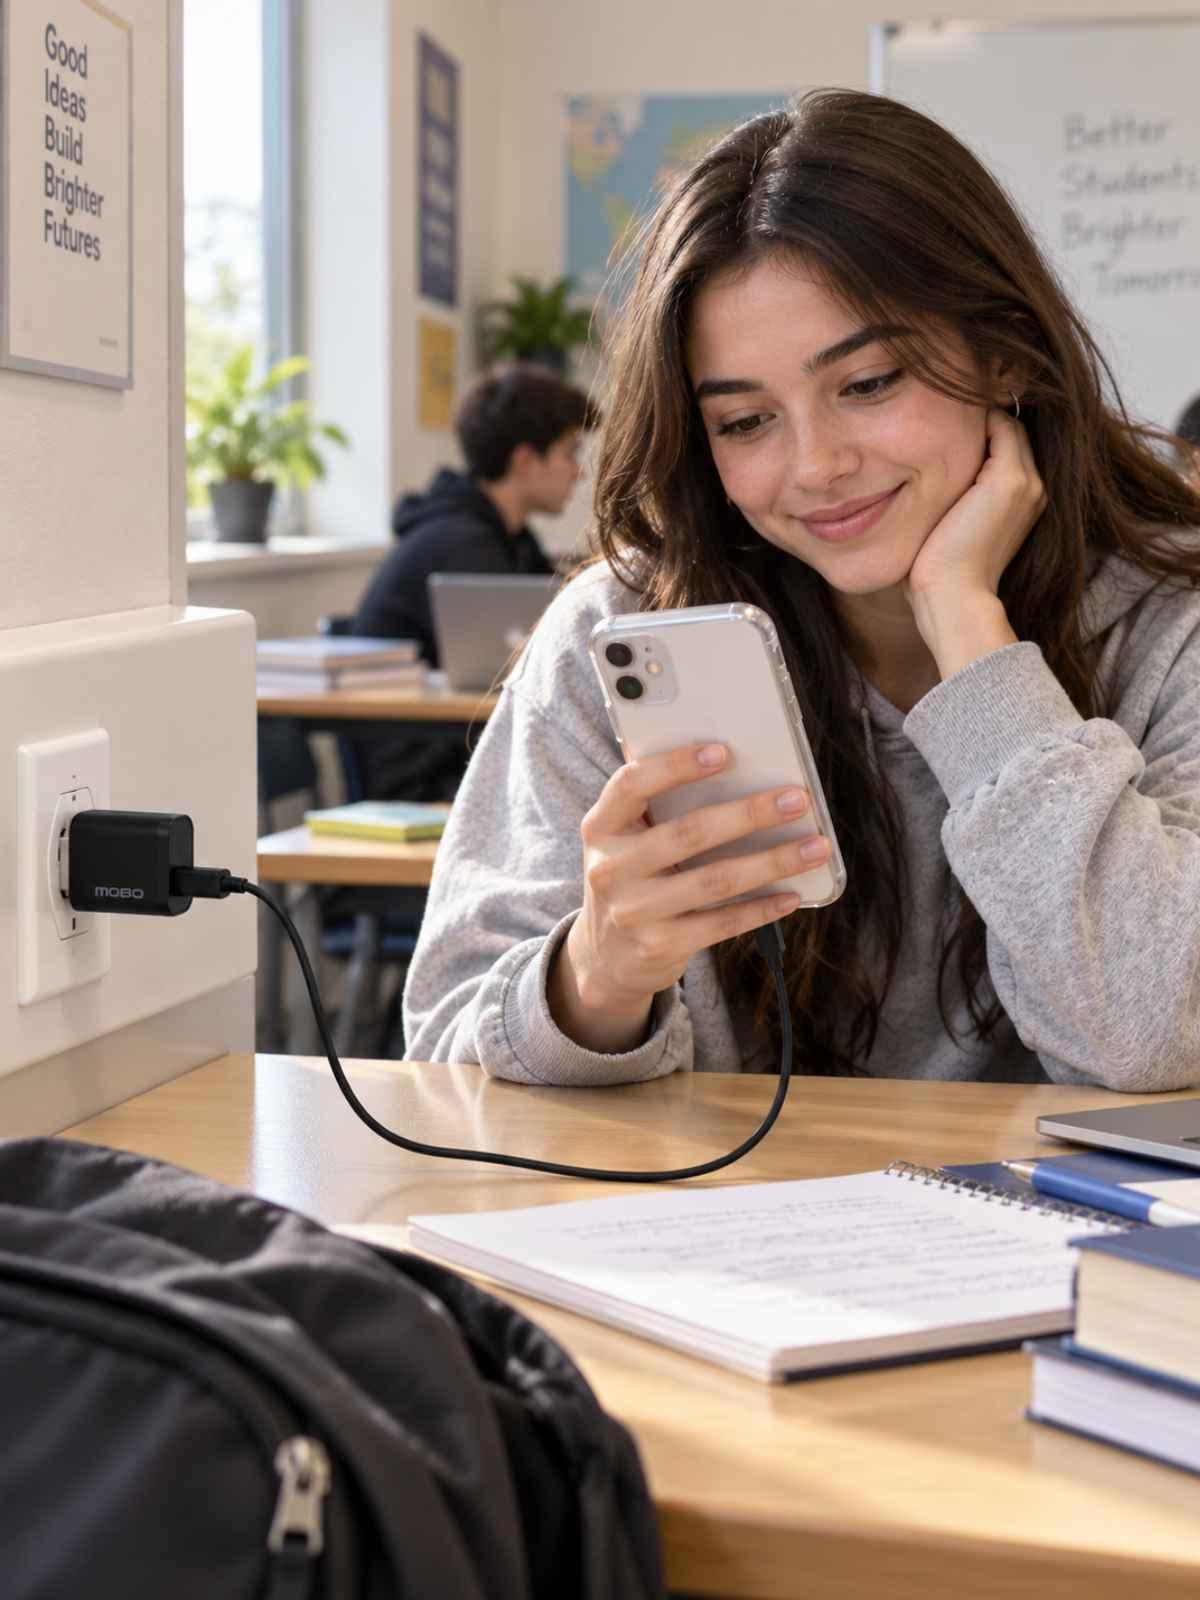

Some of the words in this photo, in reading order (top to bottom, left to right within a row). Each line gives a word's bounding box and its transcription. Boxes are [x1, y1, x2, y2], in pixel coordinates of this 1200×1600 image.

[45, 23, 87, 79] Good
[45, 67, 86, 122] Ideas
[45, 114, 83, 166] Build
[1063, 112, 1171, 151] Better
[44, 161, 104, 217] Brighter
[44, 209, 101, 261] Futures
[1061, 211, 1181, 260] Brighter
[95, 886, 144, 899] MOBO
